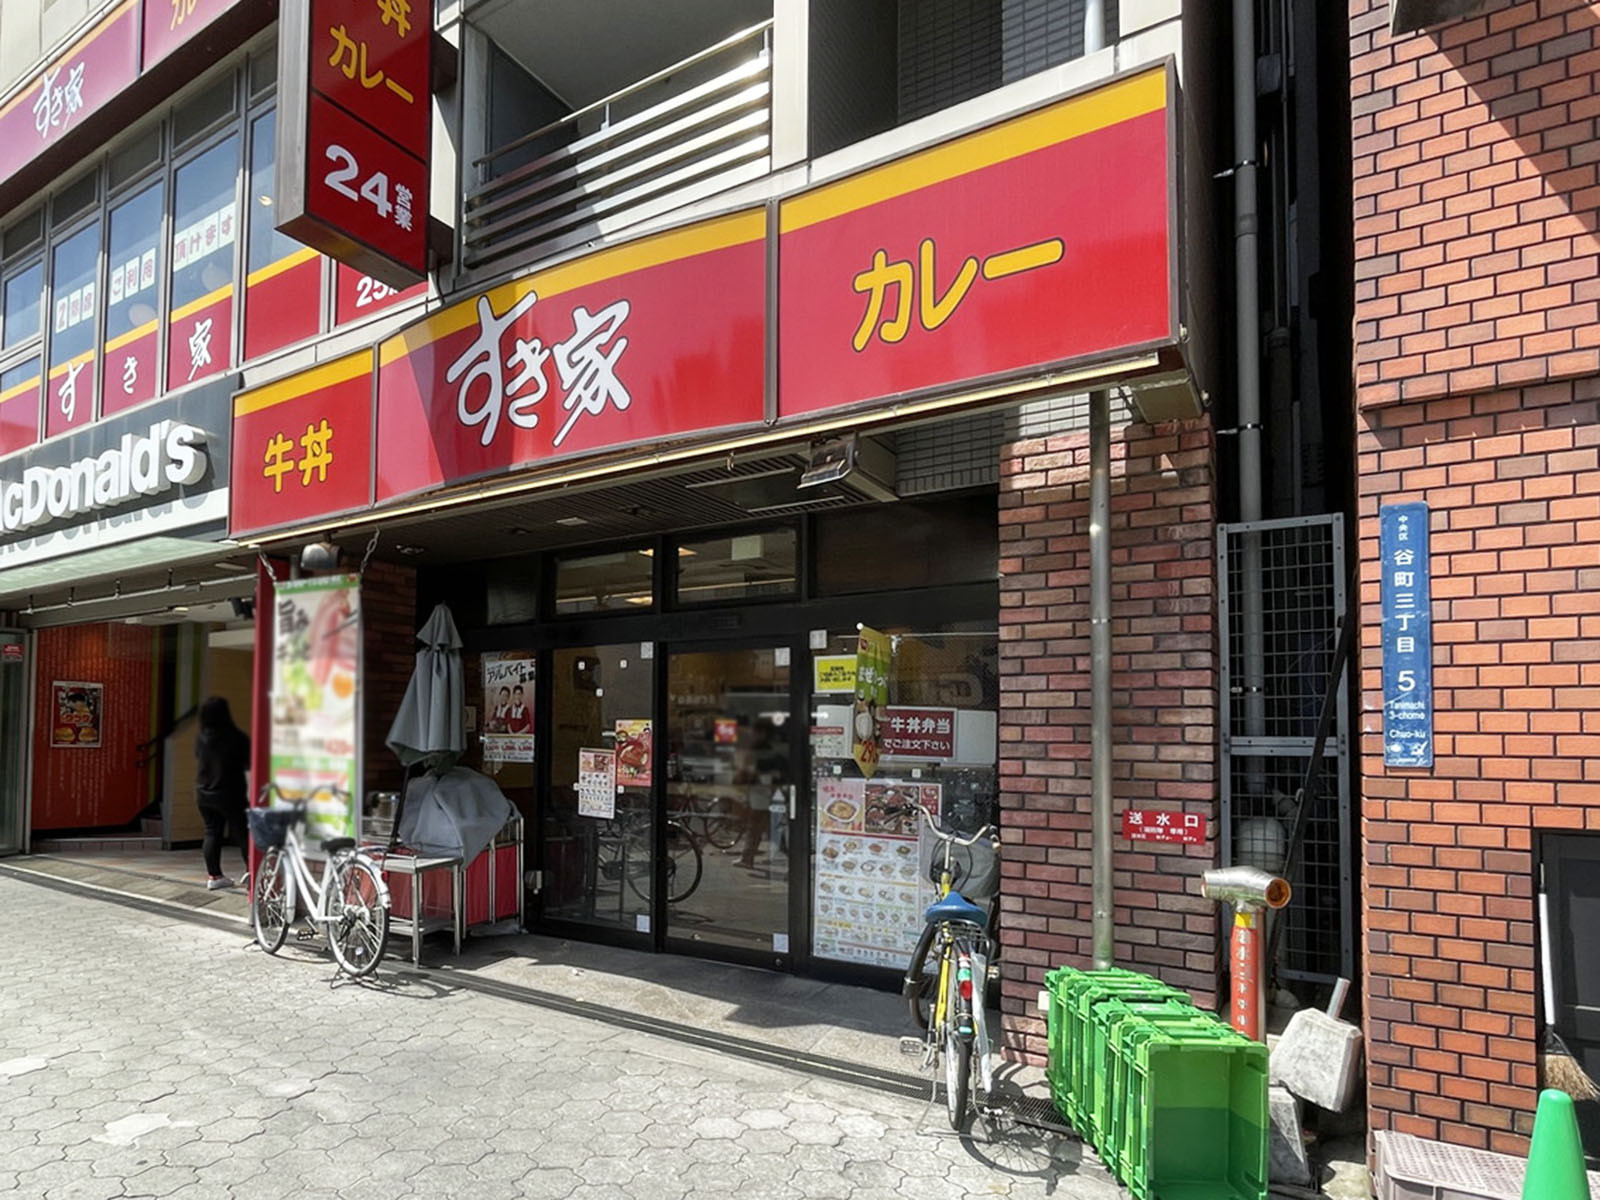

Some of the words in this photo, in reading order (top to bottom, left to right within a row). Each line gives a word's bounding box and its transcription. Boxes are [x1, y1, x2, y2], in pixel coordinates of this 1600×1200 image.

[32, 61, 85, 139] すき家
[328, 24, 414, 104] カレー
[324, 144, 393, 218] 24
[851, 238, 1066, 353] カレー
[446, 291, 632, 447] すき家
[0, 419, 207, 534] cDonald's
[263, 418, 335, 494] 牛丼
[1393, 549, 1417, 654] 谷町三丁目
[1388, 710, 1426, 721] 3-chome
[1389, 700, 1426, 711] Tanimachi
[1397, 670, 1416, 692] 5
[1388, 729, 1426, 739] Chuo-ku
[1128, 810, 1199, 829] 送水口
